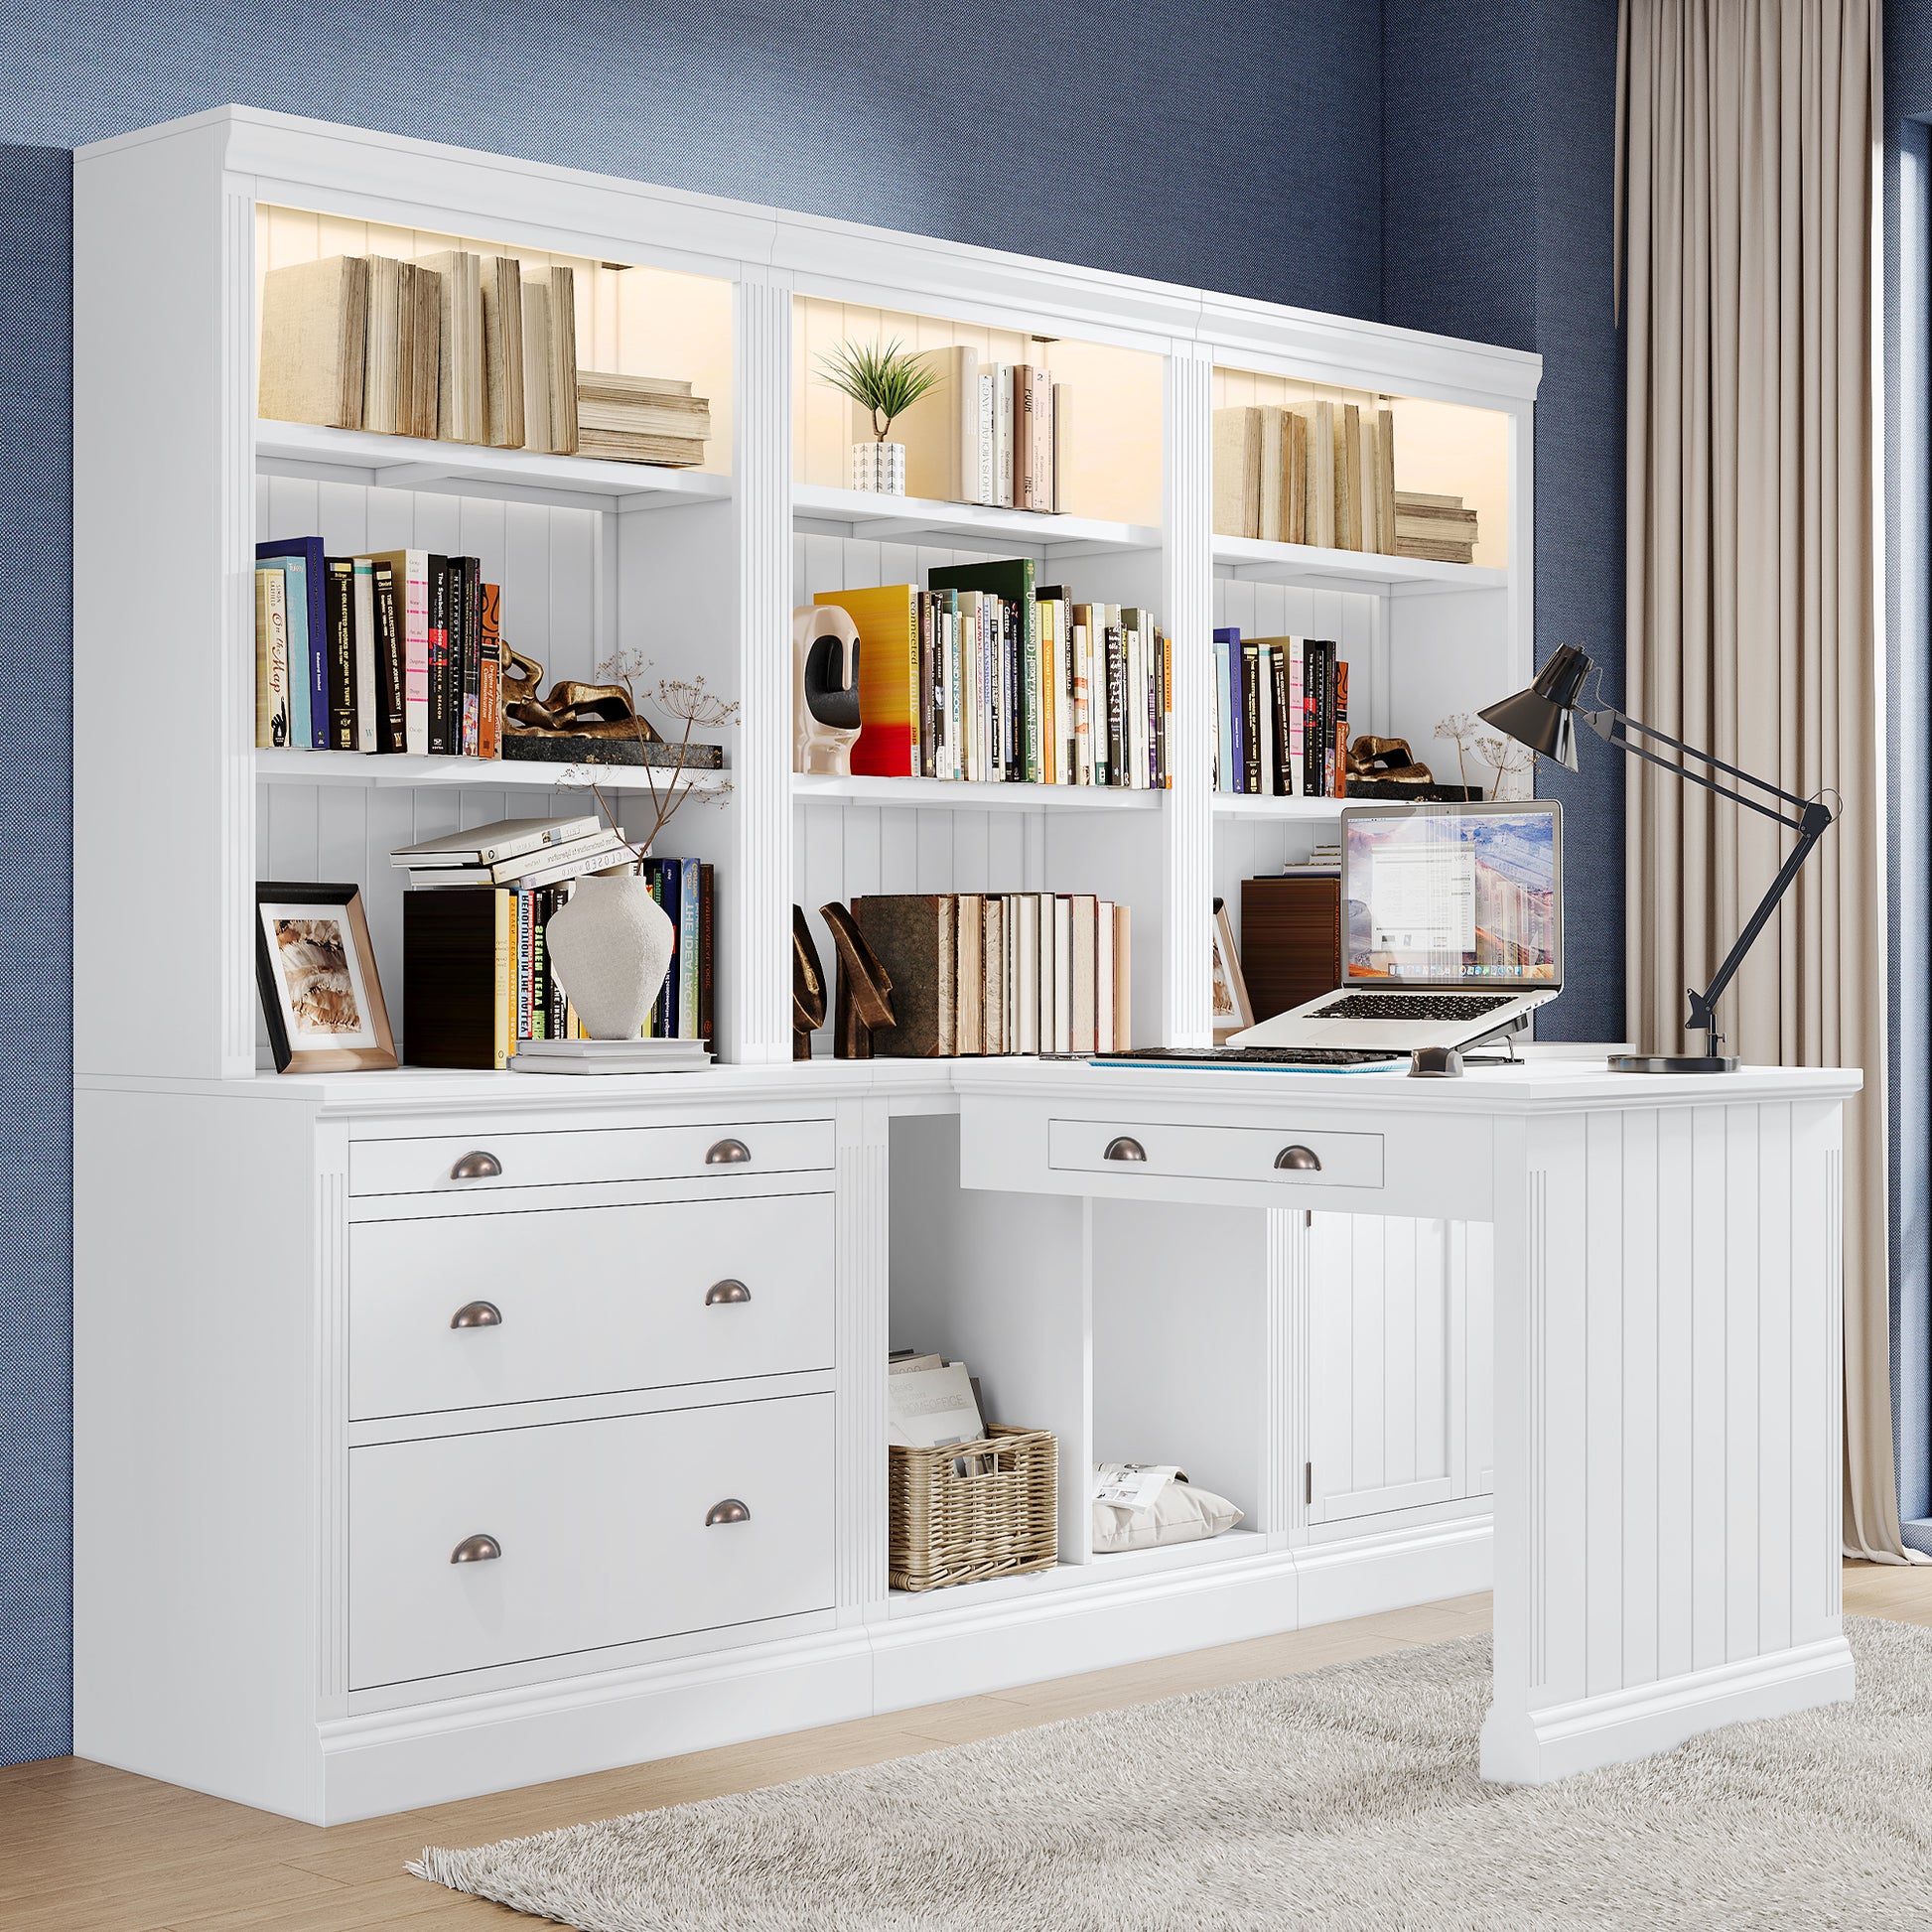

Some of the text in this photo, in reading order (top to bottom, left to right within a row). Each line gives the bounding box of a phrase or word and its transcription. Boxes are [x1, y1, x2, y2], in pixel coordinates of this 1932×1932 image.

[272, 613, 283, 633] On
[1026, 591, 1036, 652] UNDERGROUND
[984, 627, 989, 638] IN
[454, 646, 459, 658] WE
[1065, 641, 1071, 651] IN
[392, 658, 398, 667] OF
[269, 646, 285, 693] Map
[393, 683, 399, 692] W.
[910, 670, 919, 714] family
[487, 690, 493, 699] of
[454, 700, 459, 712] BY
[1027, 725, 1037, 761] EDUCATION
